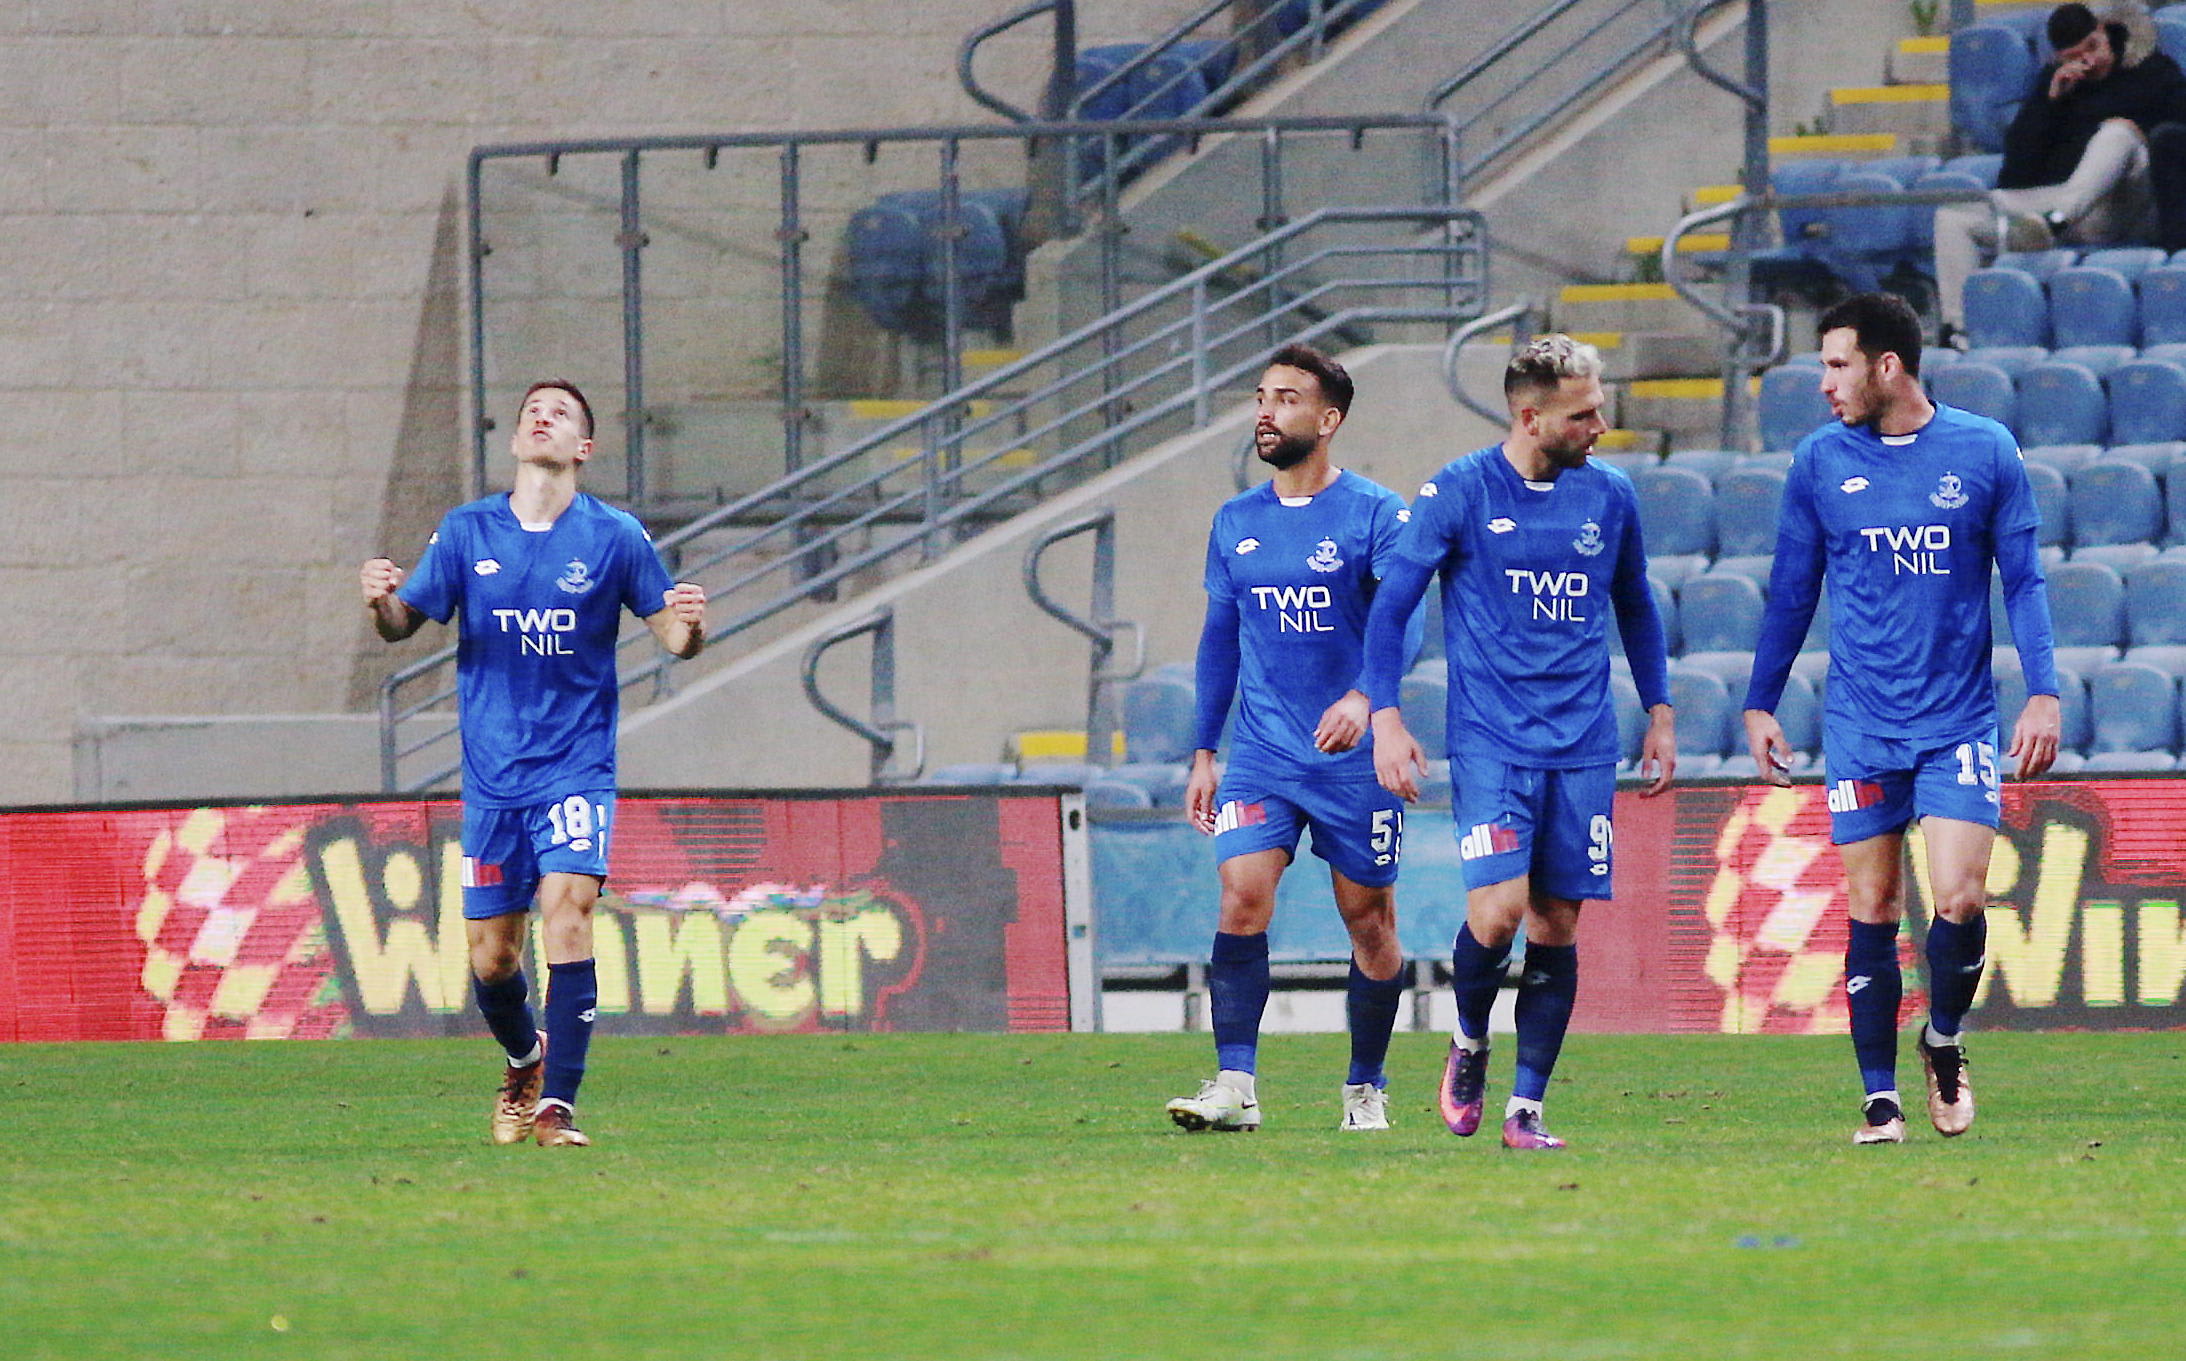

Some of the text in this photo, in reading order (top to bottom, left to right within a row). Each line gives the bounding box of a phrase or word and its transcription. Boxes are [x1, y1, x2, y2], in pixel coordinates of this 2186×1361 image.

[1860, 525, 1950, 552] TWO
[1893, 552, 1951, 575] NIL
[1504, 569, 1588, 597] TWO
[1250, 585, 1331, 610] TWO
[1532, 598, 1586, 622] NIL
[492, 608, 576, 633] TWO
[1279, 610, 1335, 633] NIL
[521, 633, 574, 656] NIL
[1955, 741, 1997, 790] 15
[547, 795, 593, 845] 18
[1370, 809, 1393, 852] 5
[1587, 814, 1608, 862] 9
[320, 836, 901, 1017] Wnner
